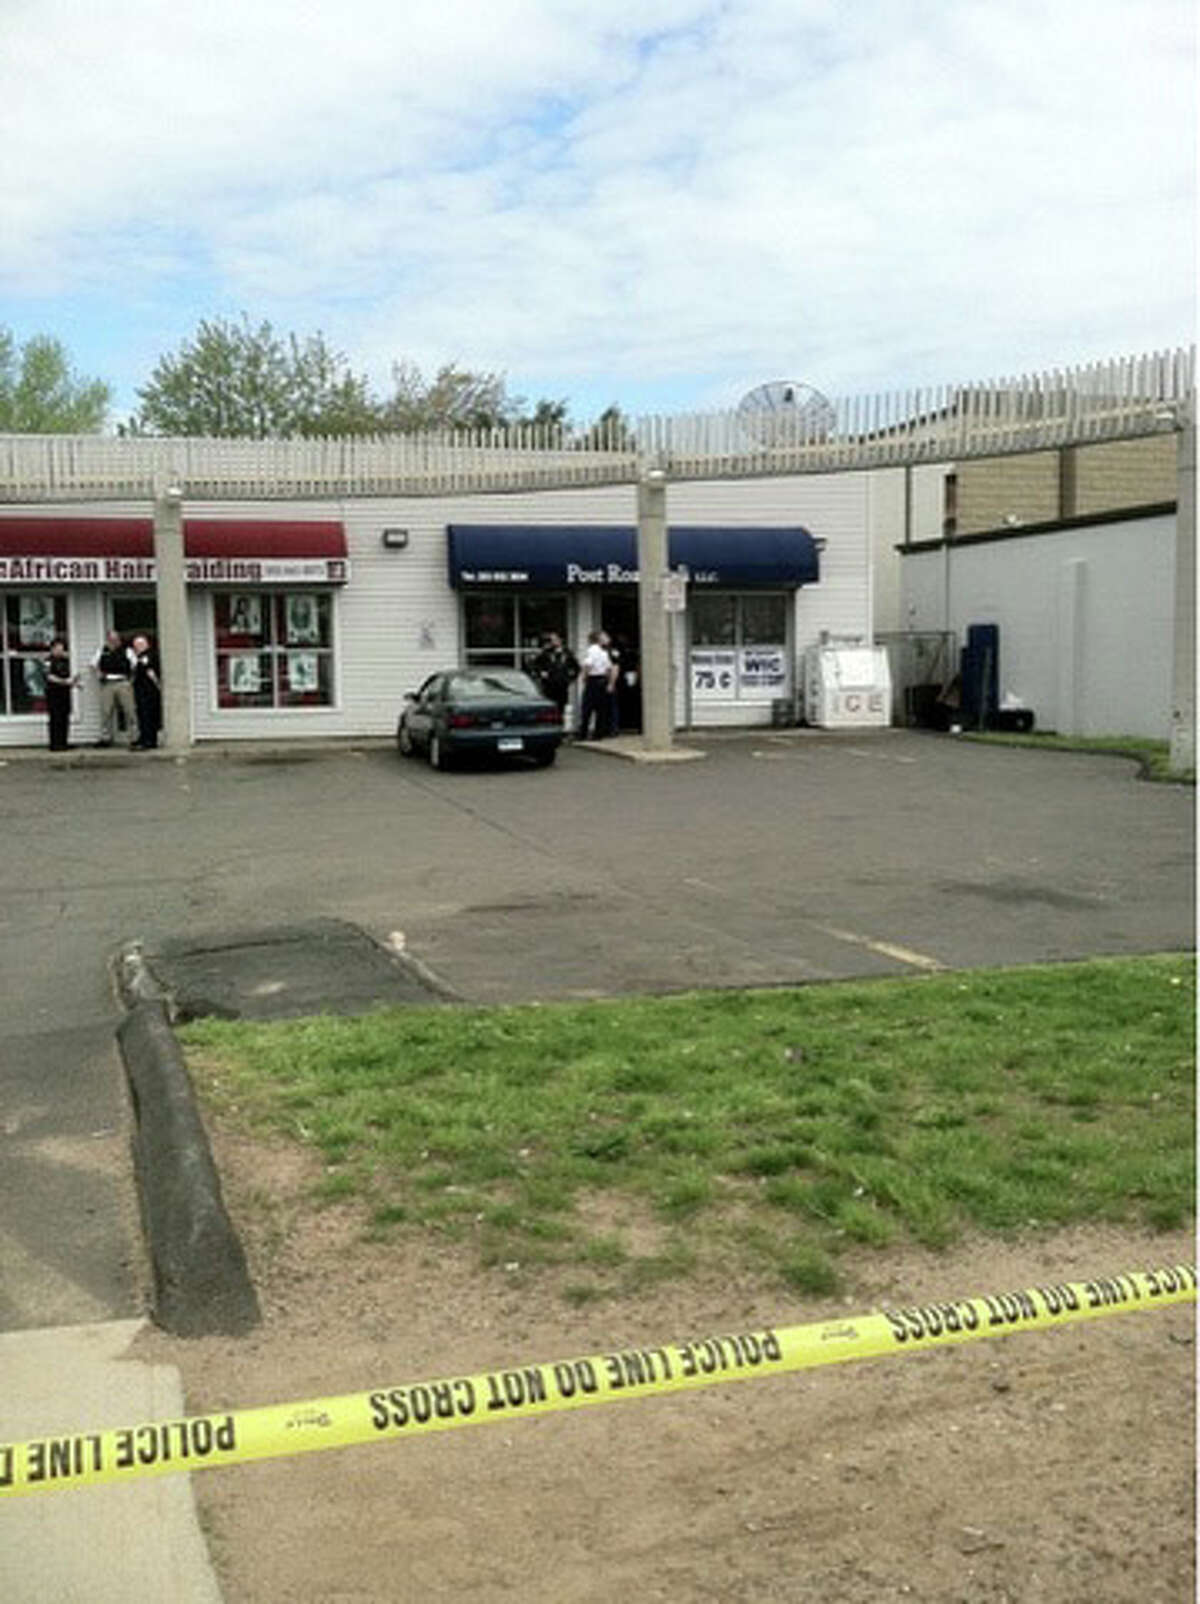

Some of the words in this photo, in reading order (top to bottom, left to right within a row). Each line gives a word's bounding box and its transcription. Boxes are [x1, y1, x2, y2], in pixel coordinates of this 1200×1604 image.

[105, 559, 156, 579] Hair
[187, 559, 261, 582] aiding
[567, 564, 603, 582] Post
[607, 564, 640, 582] Roa
[745, 658, 780, 672] WIC
[832, 694, 883, 713] ICE
[988, 1288, 1038, 1325] NOT
[1042, 1282, 1079, 1313] DO
[1085, 1271, 1141, 1308] LINE
[886, 1303, 979, 1343] CROSS
[608, 1346, 674, 1389] LINE
[680, 1330, 782, 1377] POLICE
[487, 1367, 547, 1411] NOT
[553, 1358, 599, 1398] DO
[369, 1378, 477, 1431] CROSS
[28, 1434, 102, 1483] LINE
[115, 1415, 236, 1468] POLICE
